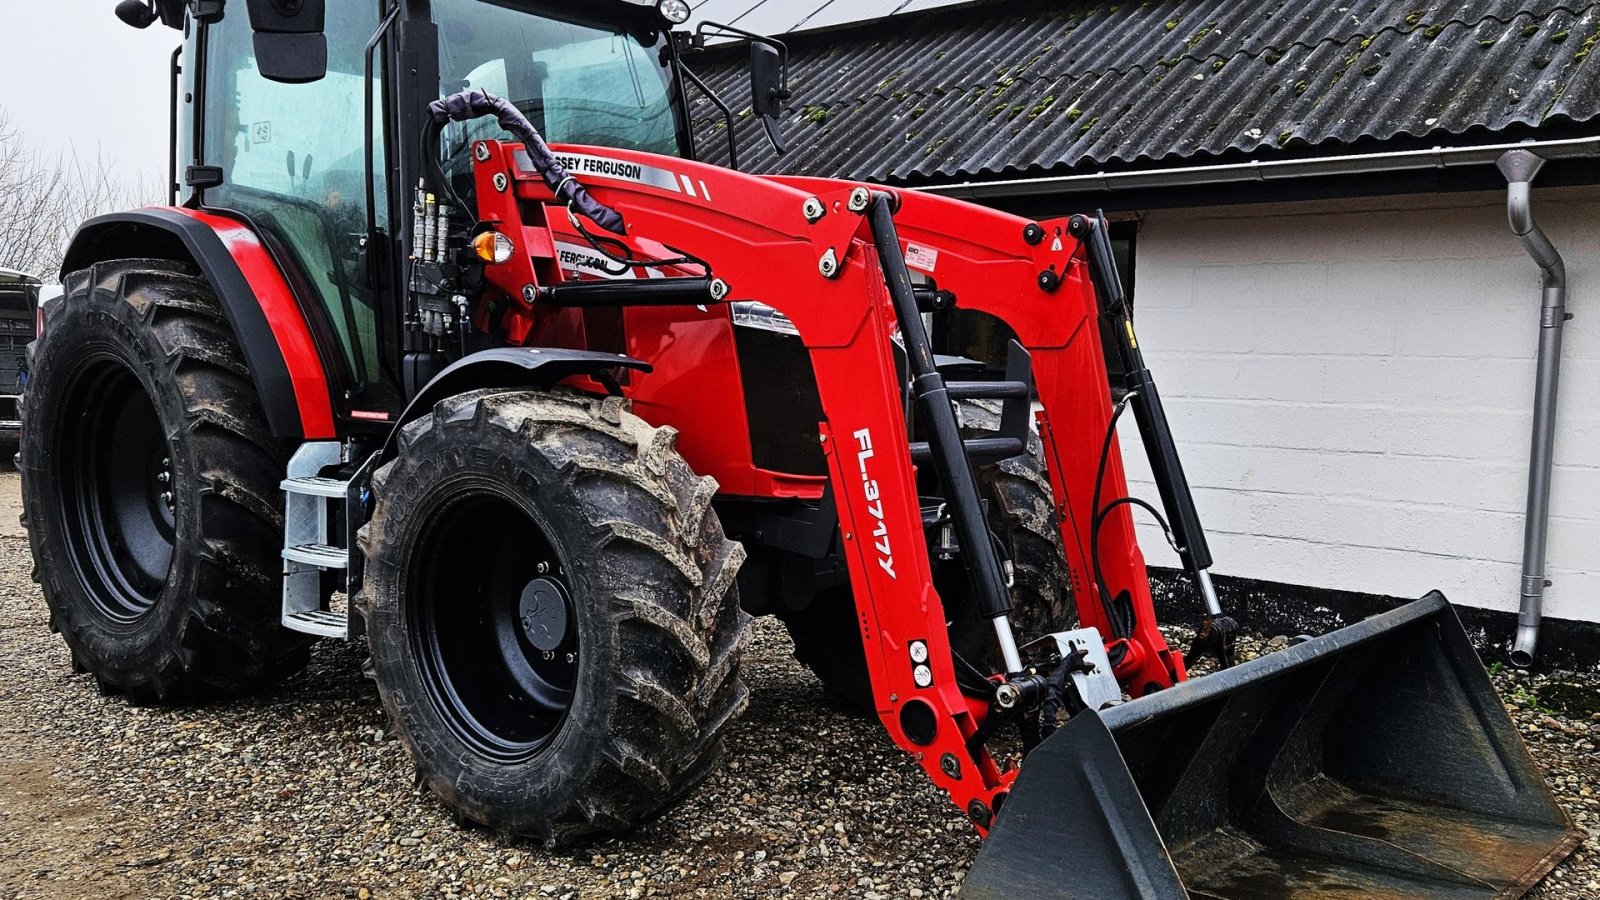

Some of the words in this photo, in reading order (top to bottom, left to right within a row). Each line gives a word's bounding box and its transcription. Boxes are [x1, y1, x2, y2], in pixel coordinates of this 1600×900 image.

[555, 156, 581, 170] SSEY
[583, 158, 641, 180] FERGUSON
[384, 446, 540, 545] GOODYEAR
[853, 427, 897, 580] FL.3717Y
